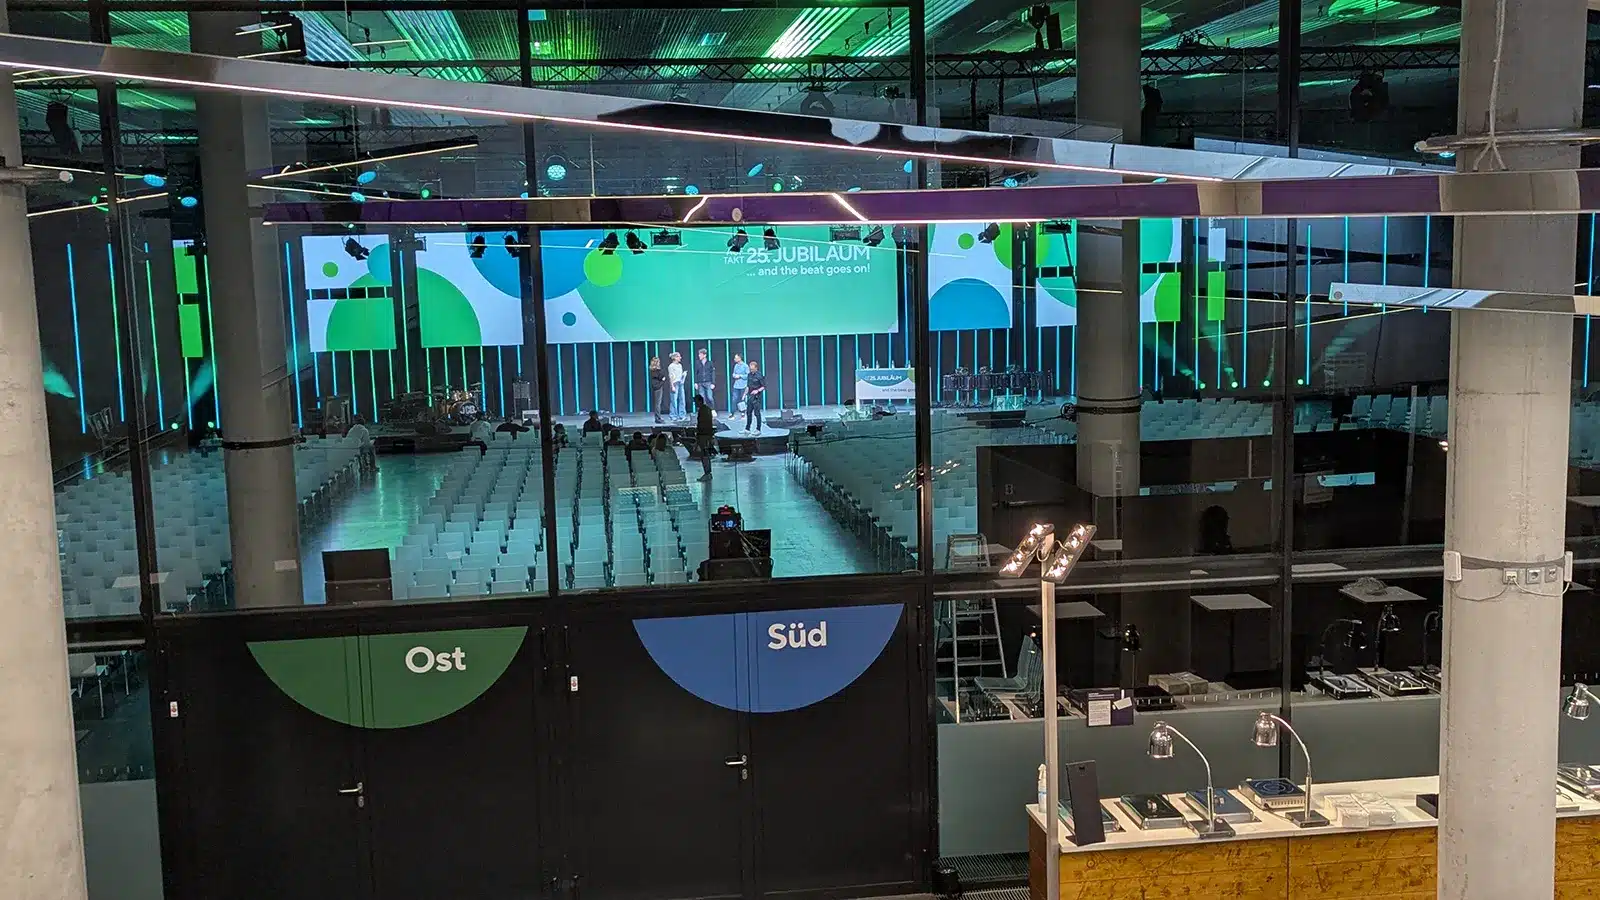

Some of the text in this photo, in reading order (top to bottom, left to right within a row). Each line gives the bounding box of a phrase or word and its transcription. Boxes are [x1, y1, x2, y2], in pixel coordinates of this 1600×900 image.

[723, 256, 744, 264] TAKT
[746, 247, 770, 264] 25.
[758, 266, 778, 276] and
[780, 265, 798, 274] the
[800, 264, 824, 274] beat
[826, 266, 852, 276] goes
[854, 262, 870, 273] on!
[768, 620, 826, 650] Süd
[405, 646, 466, 674] Ost
